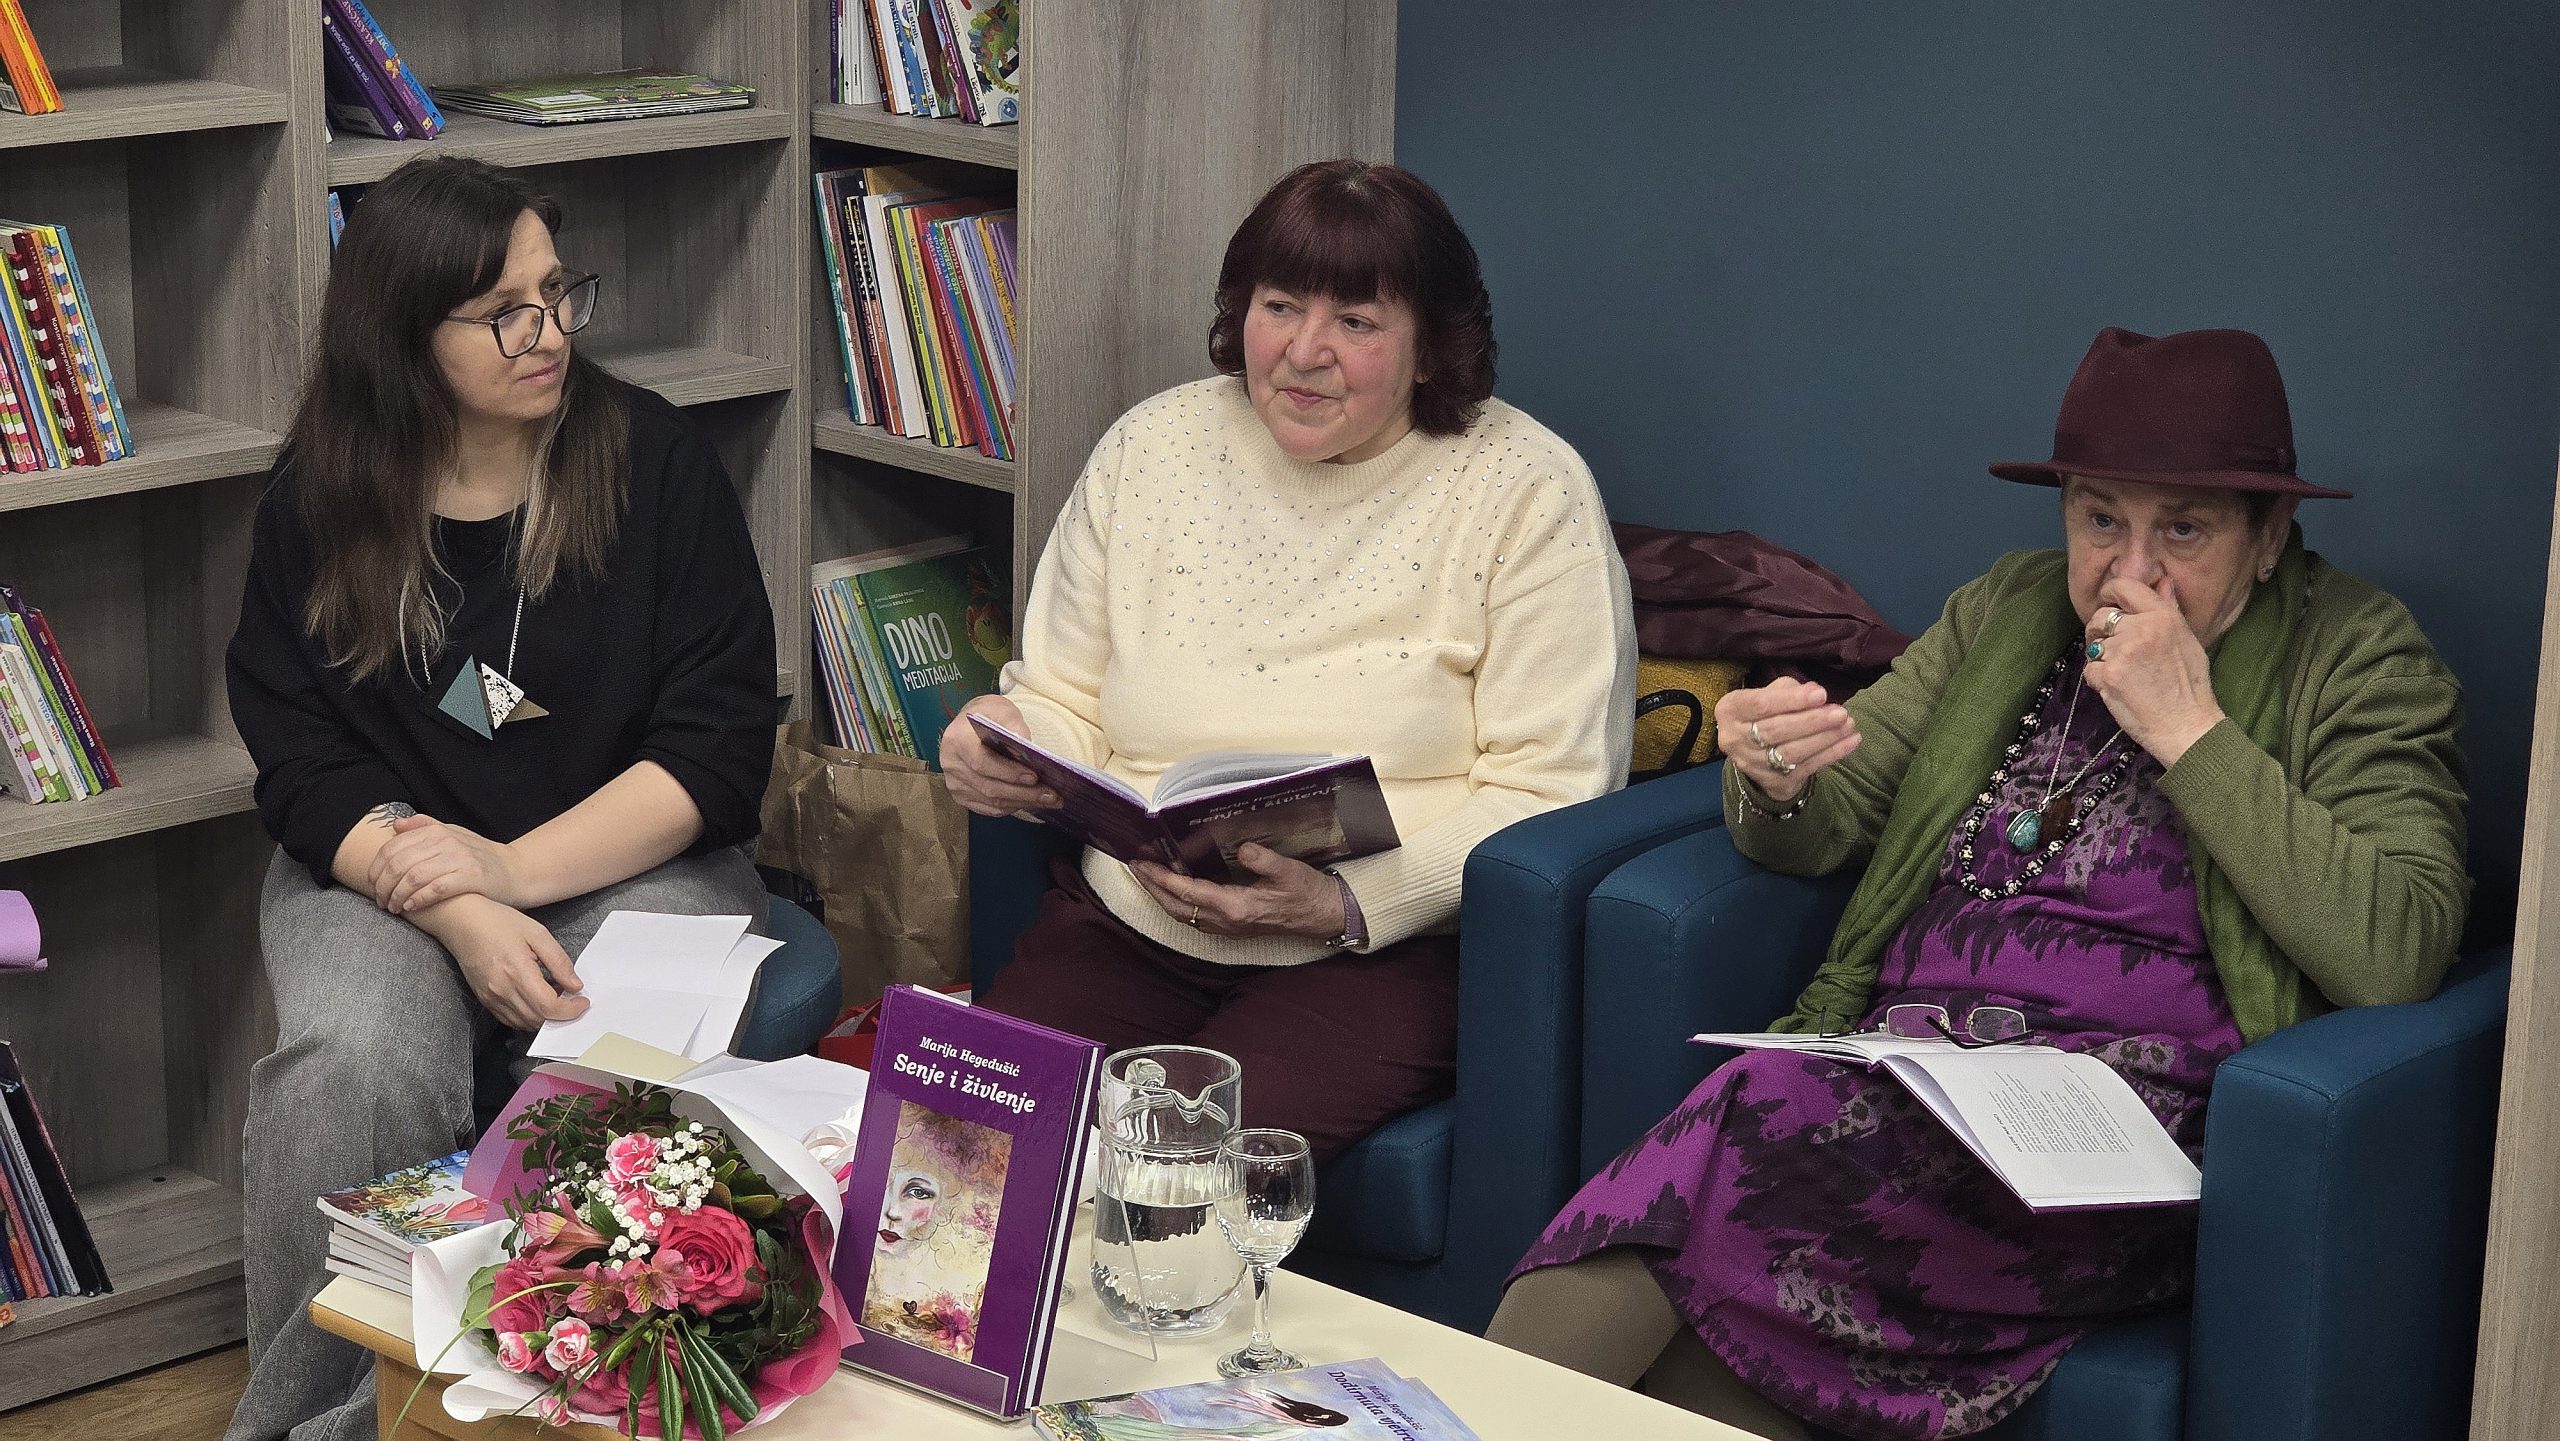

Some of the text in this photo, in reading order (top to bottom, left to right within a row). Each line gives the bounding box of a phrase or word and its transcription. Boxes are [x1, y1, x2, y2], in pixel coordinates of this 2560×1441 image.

[883, 612, 953, 670] DINO
[902, 662, 963, 692] MEDITACIJA
[919, 1036, 1020, 1077] Marija Hegedušić
[894, 1053, 1036, 1114] Senje i živlenje
[1327, 1371, 1415, 1441] Dodirnuta vjetro
[1366, 1384, 1390, 1404] Marija
